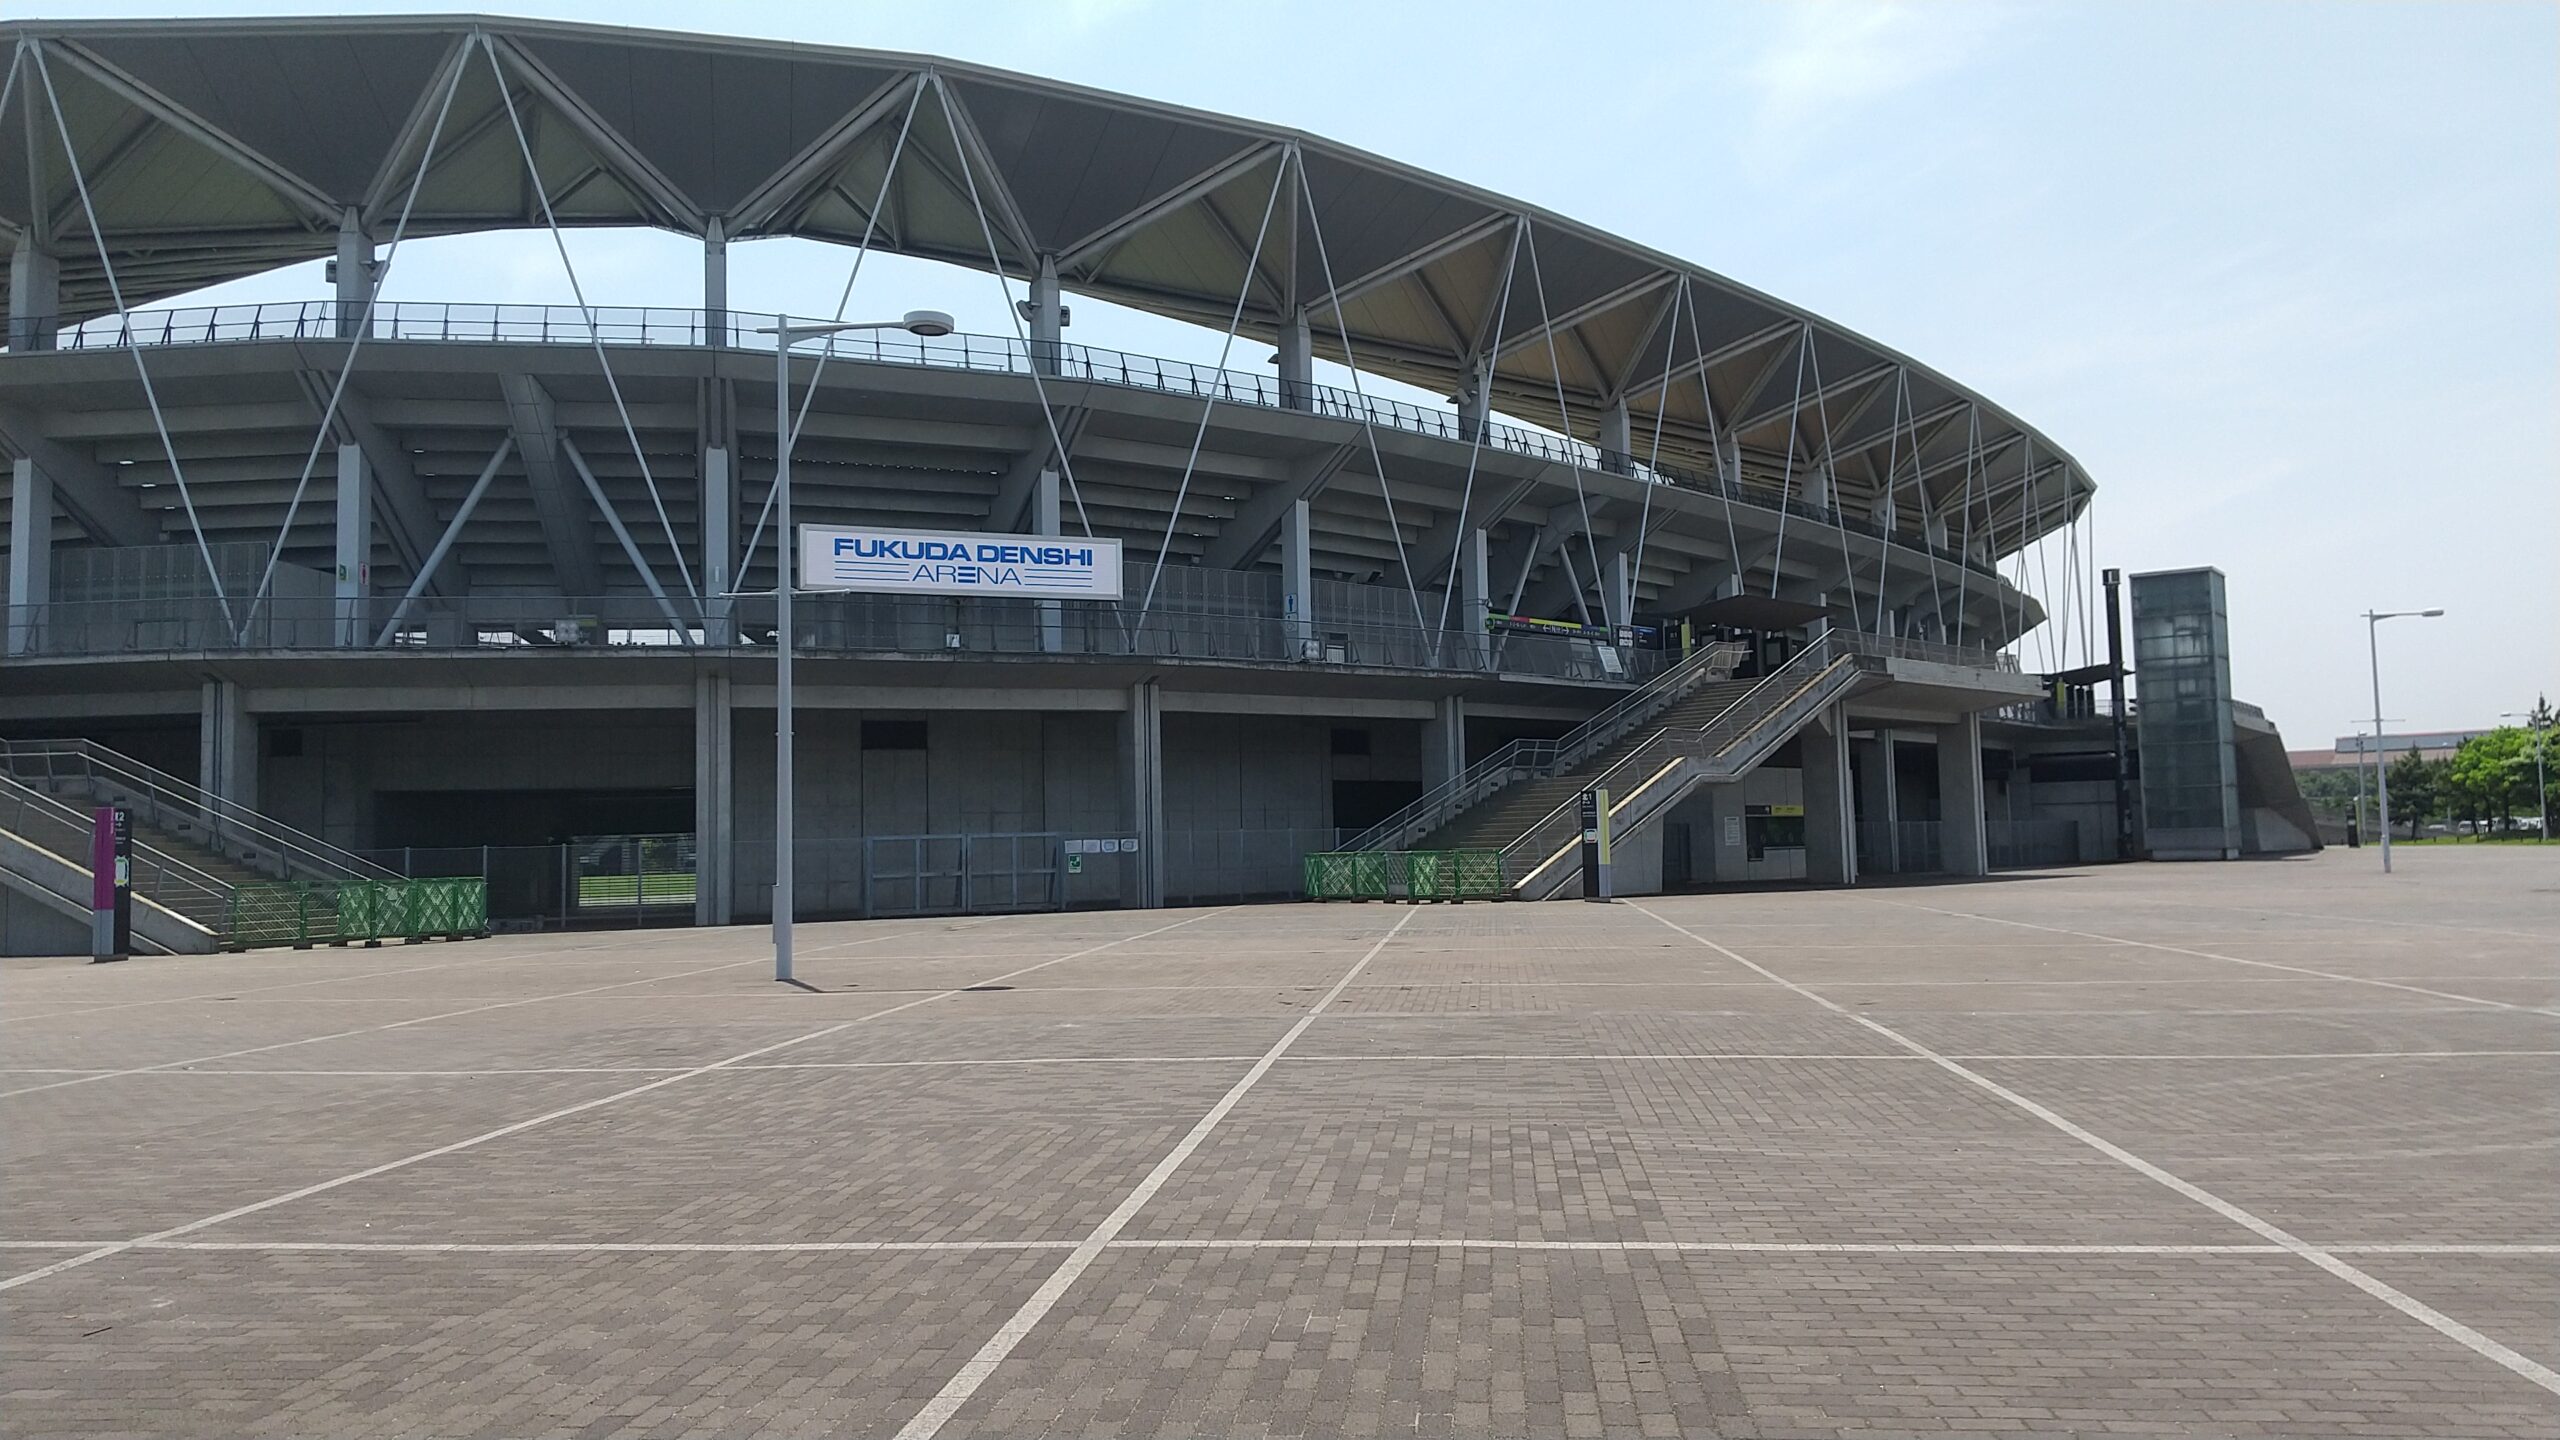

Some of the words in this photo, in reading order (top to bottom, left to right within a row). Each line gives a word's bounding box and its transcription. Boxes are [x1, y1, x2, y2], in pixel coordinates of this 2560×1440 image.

[834, 537, 972, 562] FUKUDA
[977, 544, 1093, 567] DENSHI
[912, 564, 1022, 586] ARENA
